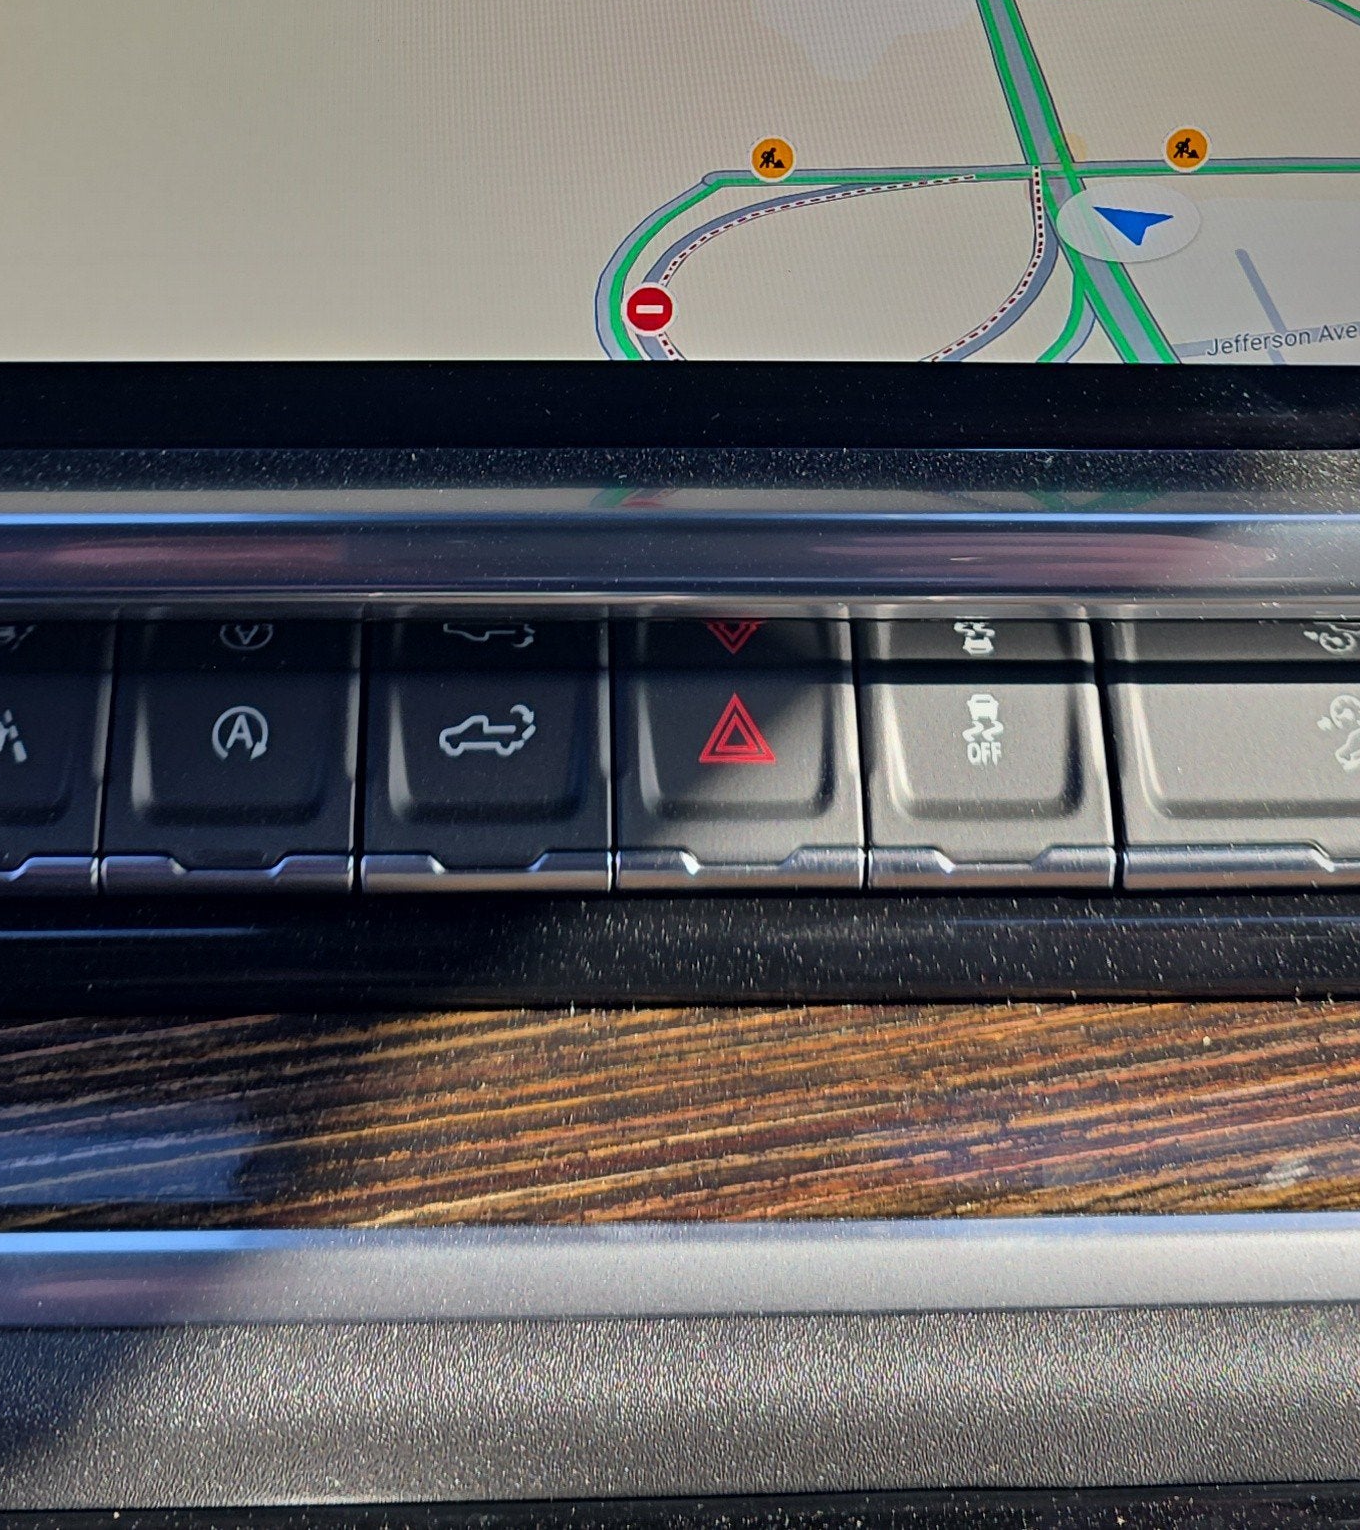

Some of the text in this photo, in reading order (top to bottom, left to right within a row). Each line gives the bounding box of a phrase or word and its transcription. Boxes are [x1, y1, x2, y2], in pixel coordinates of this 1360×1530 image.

[1207, 324, 1359, 357] Jefferson Ave
[967, 741, 1003, 767] OFF
